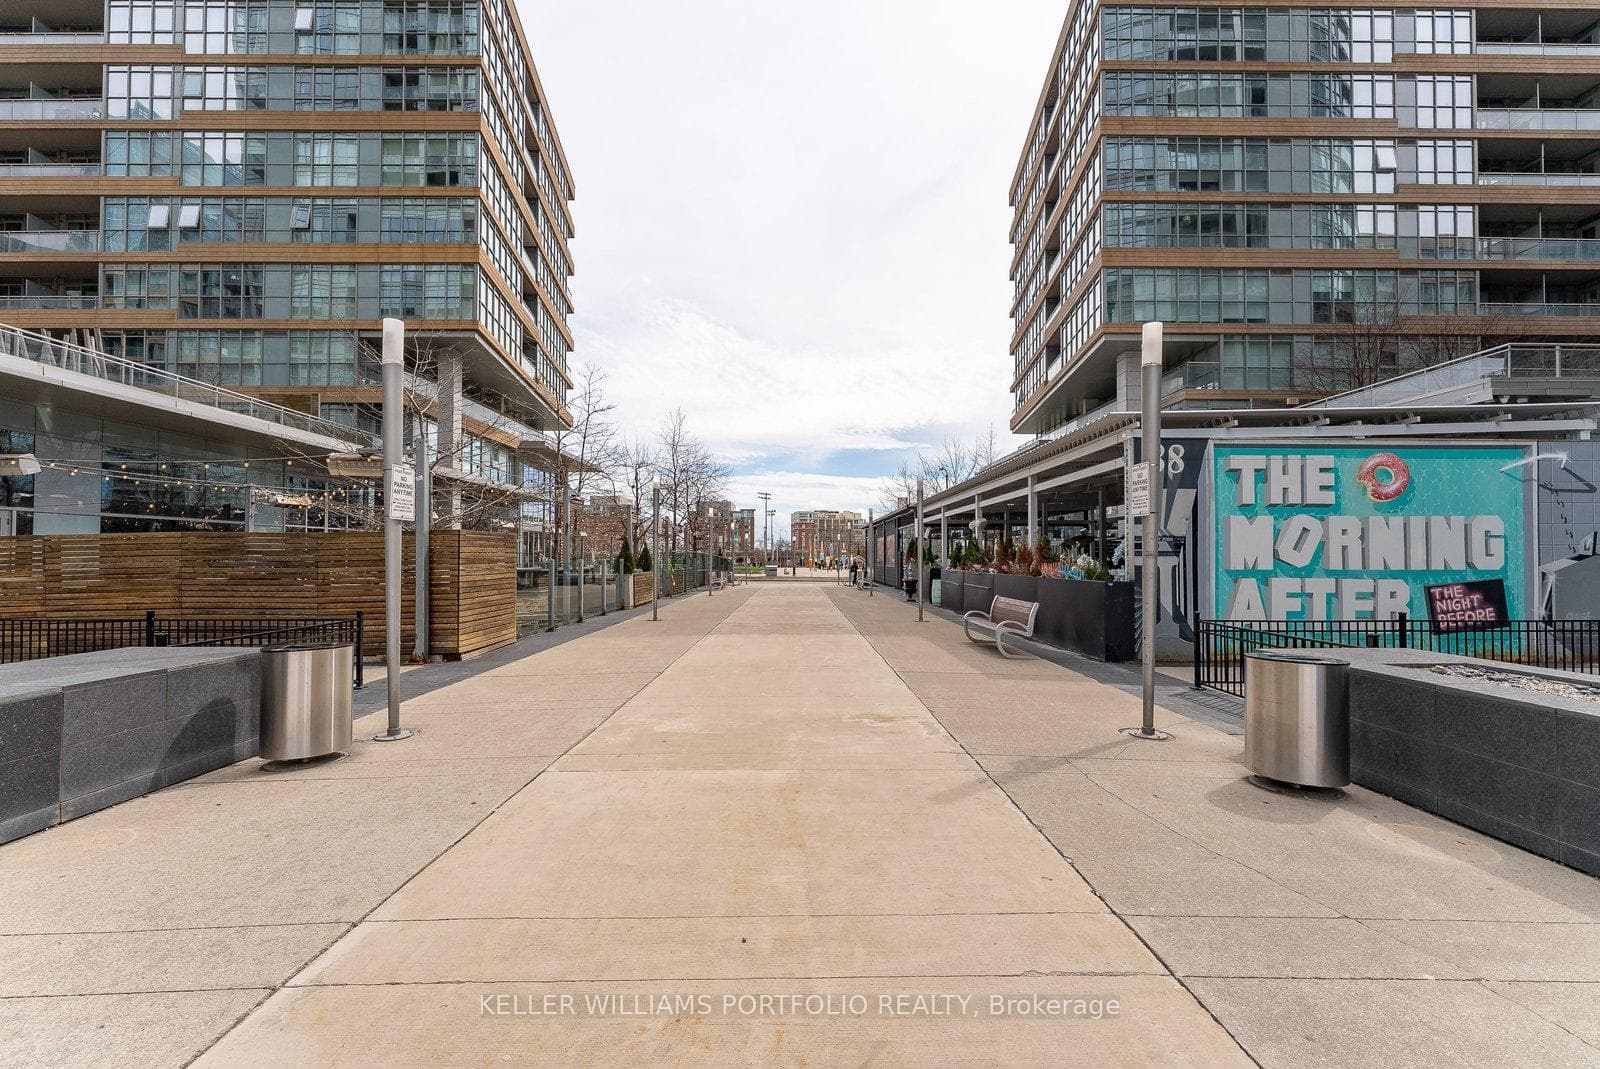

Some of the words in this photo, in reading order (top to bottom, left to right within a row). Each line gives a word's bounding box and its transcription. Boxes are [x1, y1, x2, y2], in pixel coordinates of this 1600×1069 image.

[393, 481, 413, 490] PARKING
[1226, 454, 1336, 506] THE
[393, 488, 413, 497] ANYTIME
[1226, 513, 1504, 570] MORNING
[1430, 585, 1463, 600] THE
[1228, 577, 1411, 632] AFTER
[1435, 594, 1481, 613] NIGHT
[1438, 607, 1497, 629] BEFORE
